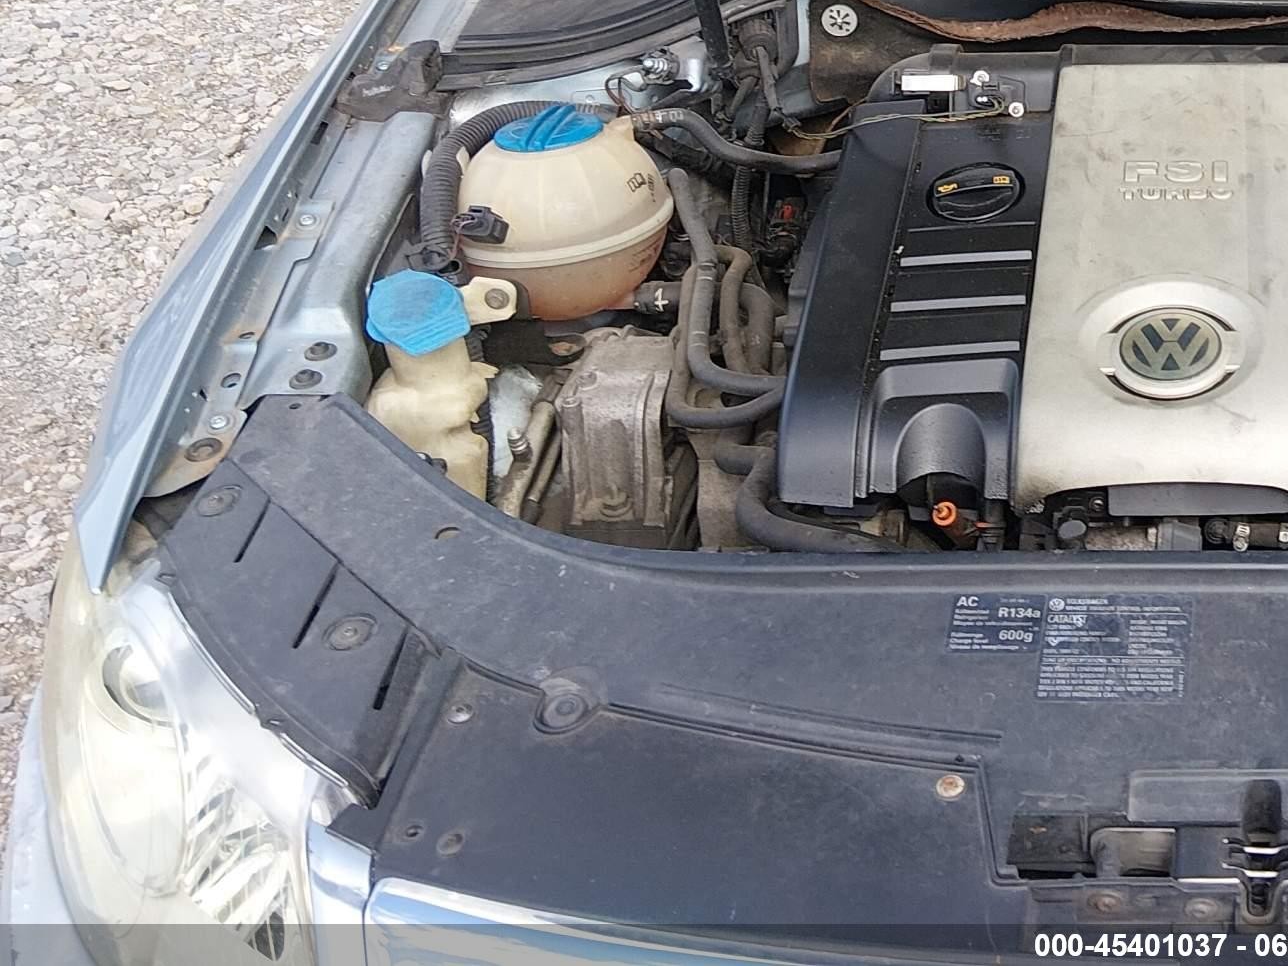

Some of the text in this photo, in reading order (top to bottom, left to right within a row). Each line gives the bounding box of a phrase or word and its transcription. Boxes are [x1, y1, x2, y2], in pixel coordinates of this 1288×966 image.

[1123, 160, 1229, 183] FSI
[1119, 186, 1234, 201] TURBO
[956, 596, 979, 607] AC
[997, 607, 1041, 618] R134a
[998, 630, 1034, 643] 600g
